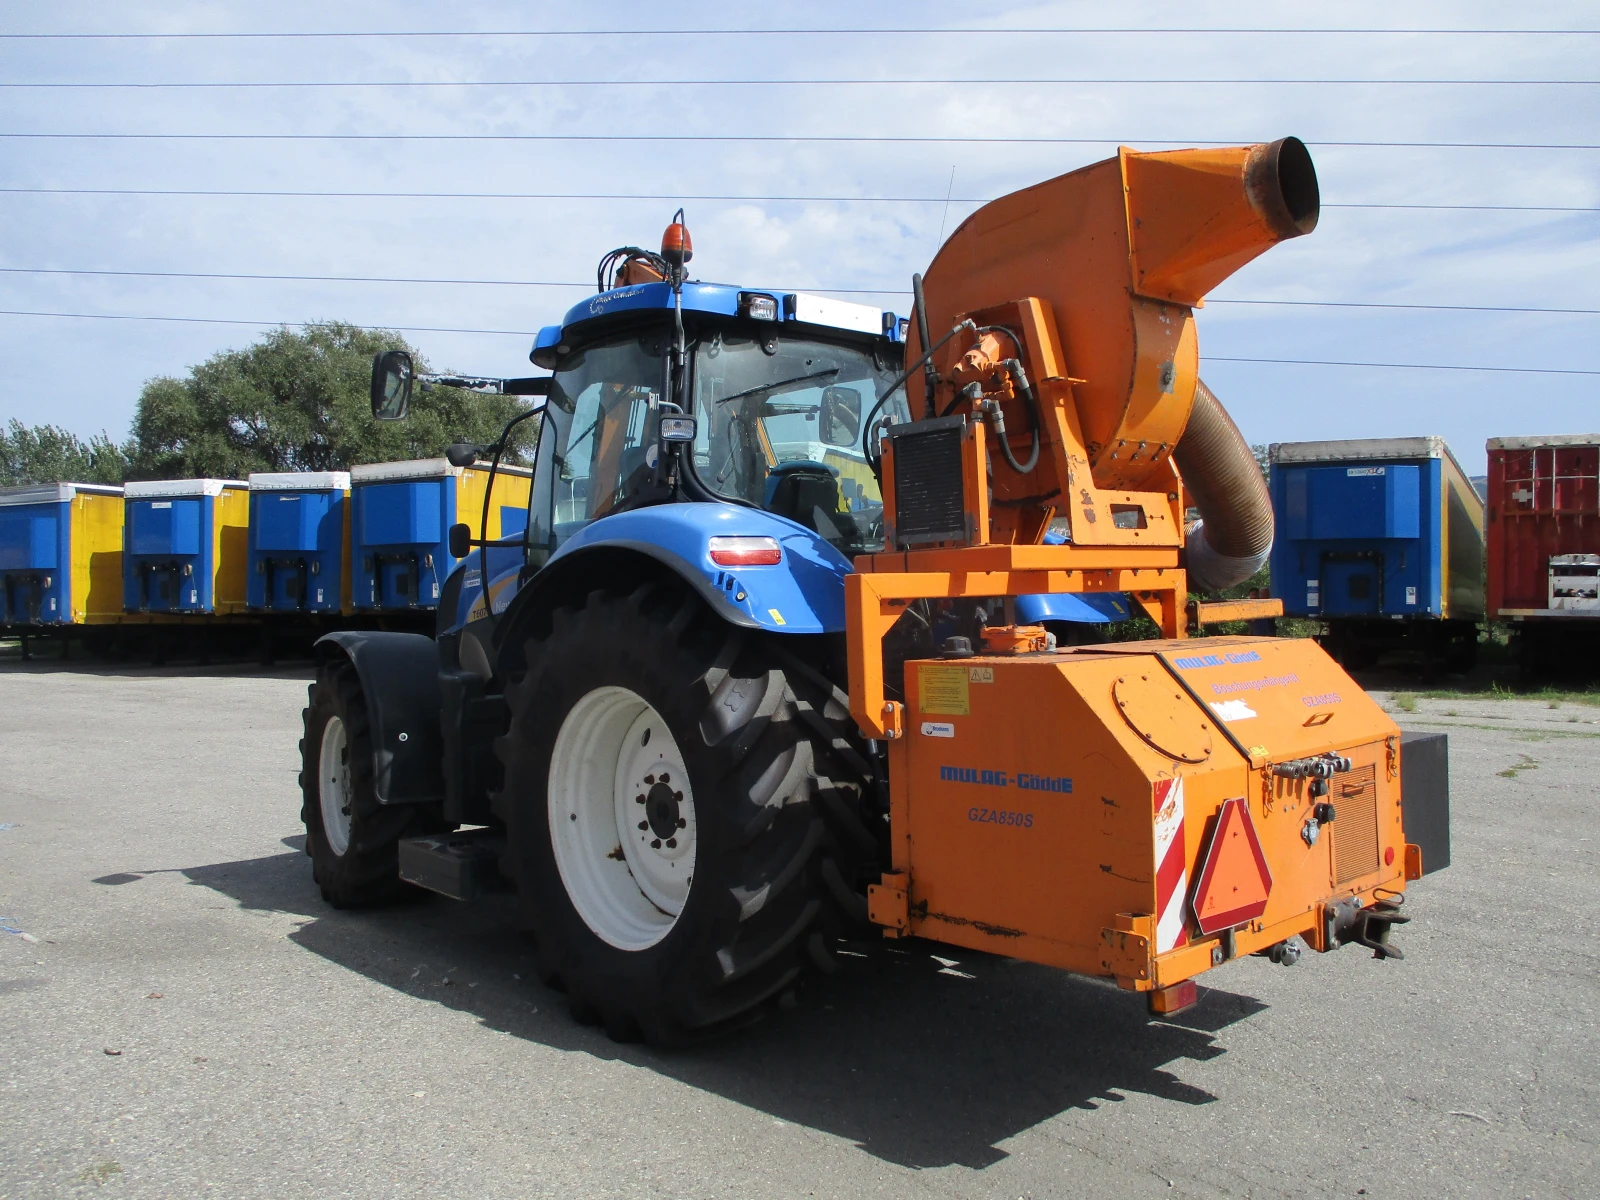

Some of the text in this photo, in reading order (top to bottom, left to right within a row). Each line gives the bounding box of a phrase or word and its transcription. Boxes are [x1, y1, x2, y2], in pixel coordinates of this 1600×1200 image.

[472, 608, 489, 620] T607
[1302, 693, 1342, 706] GZA850S
[968, 807, 1034, 828] GZA850S
